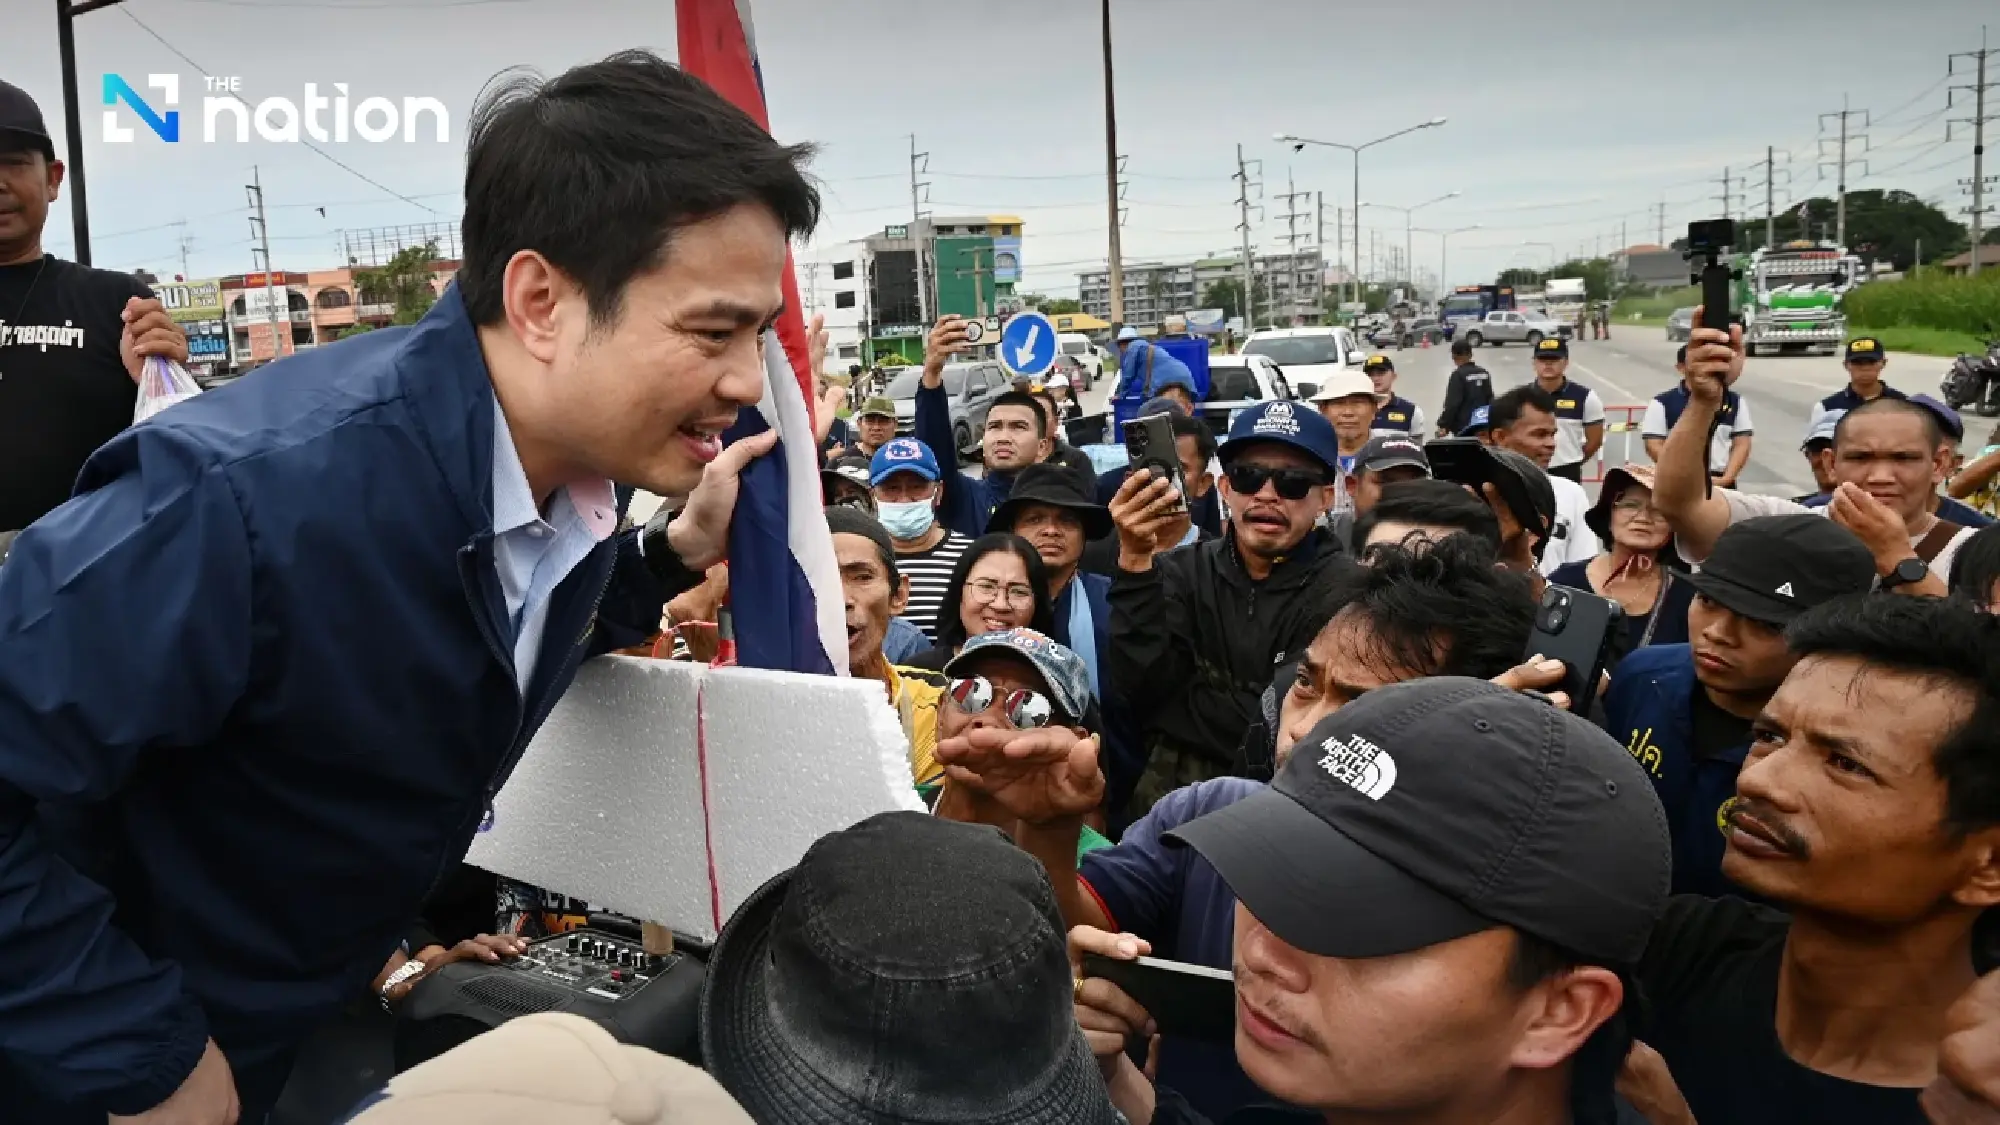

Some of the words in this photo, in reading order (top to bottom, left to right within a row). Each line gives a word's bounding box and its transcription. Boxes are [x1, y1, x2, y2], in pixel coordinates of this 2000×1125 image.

[1319, 736, 1370, 774] NORTH
[1347, 733, 1379, 761] THE
[1317, 755, 1358, 784] FACE
